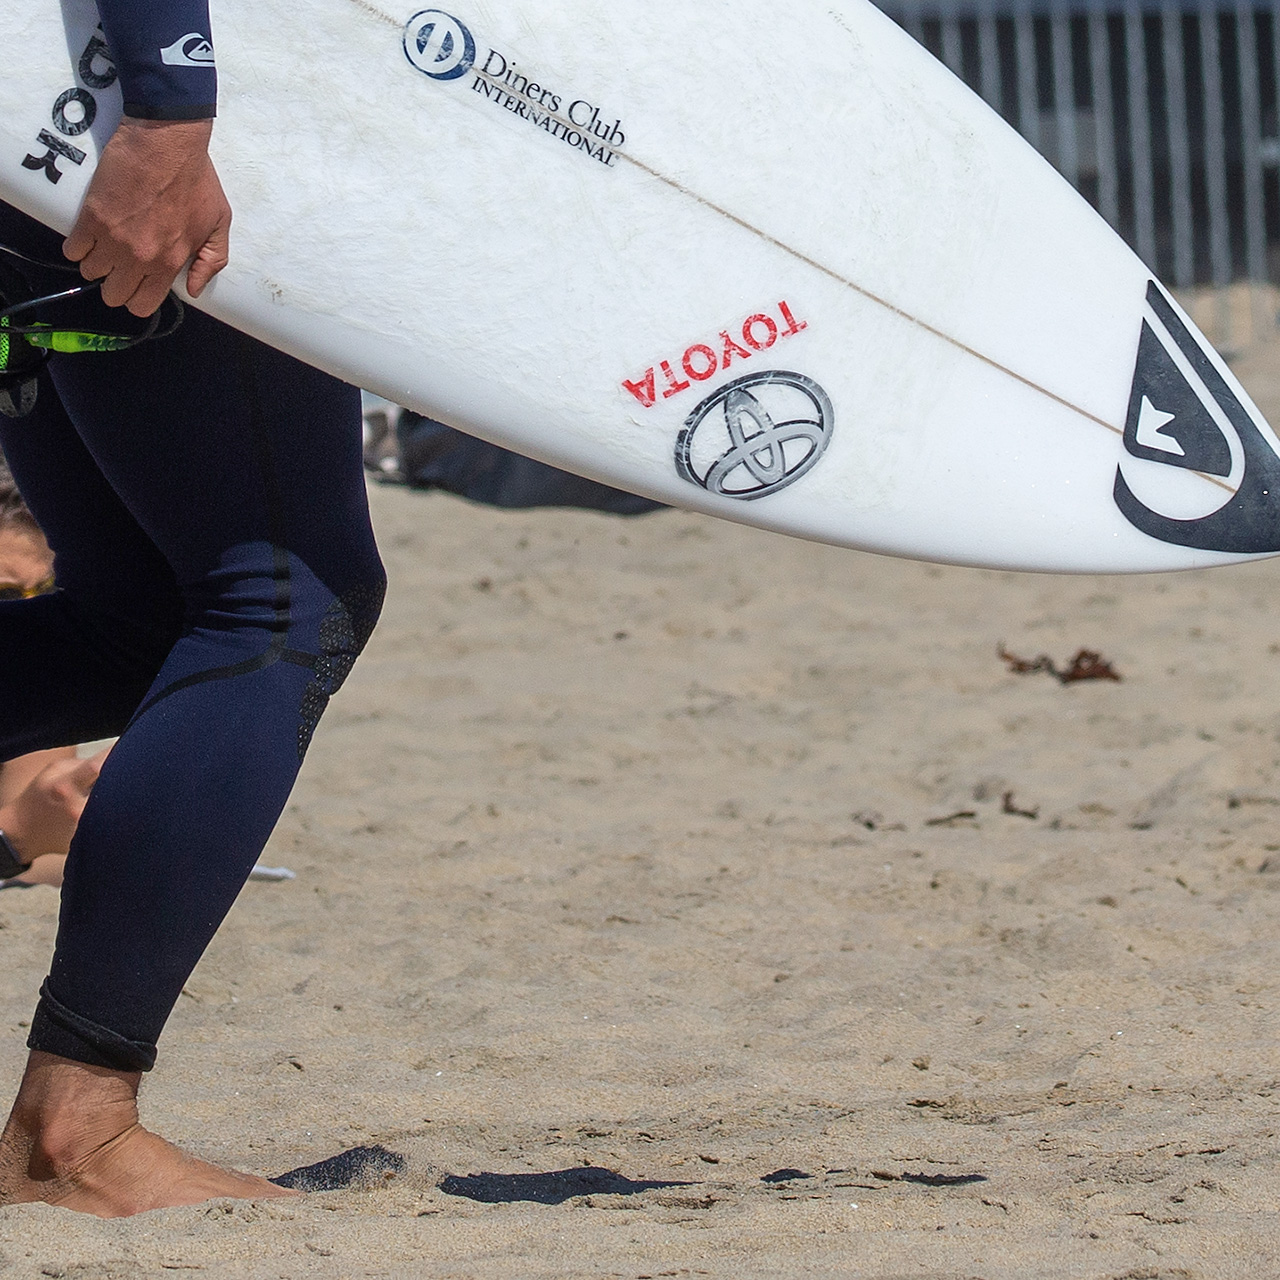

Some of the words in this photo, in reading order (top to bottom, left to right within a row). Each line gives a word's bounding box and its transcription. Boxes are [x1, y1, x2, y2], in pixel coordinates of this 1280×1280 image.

[471, 75, 616, 168] INTERNATIONAL
[481, 48, 562, 113] Diners
[568, 99, 626, 148] Club
[621, 300, 808, 408] TOYOTA
